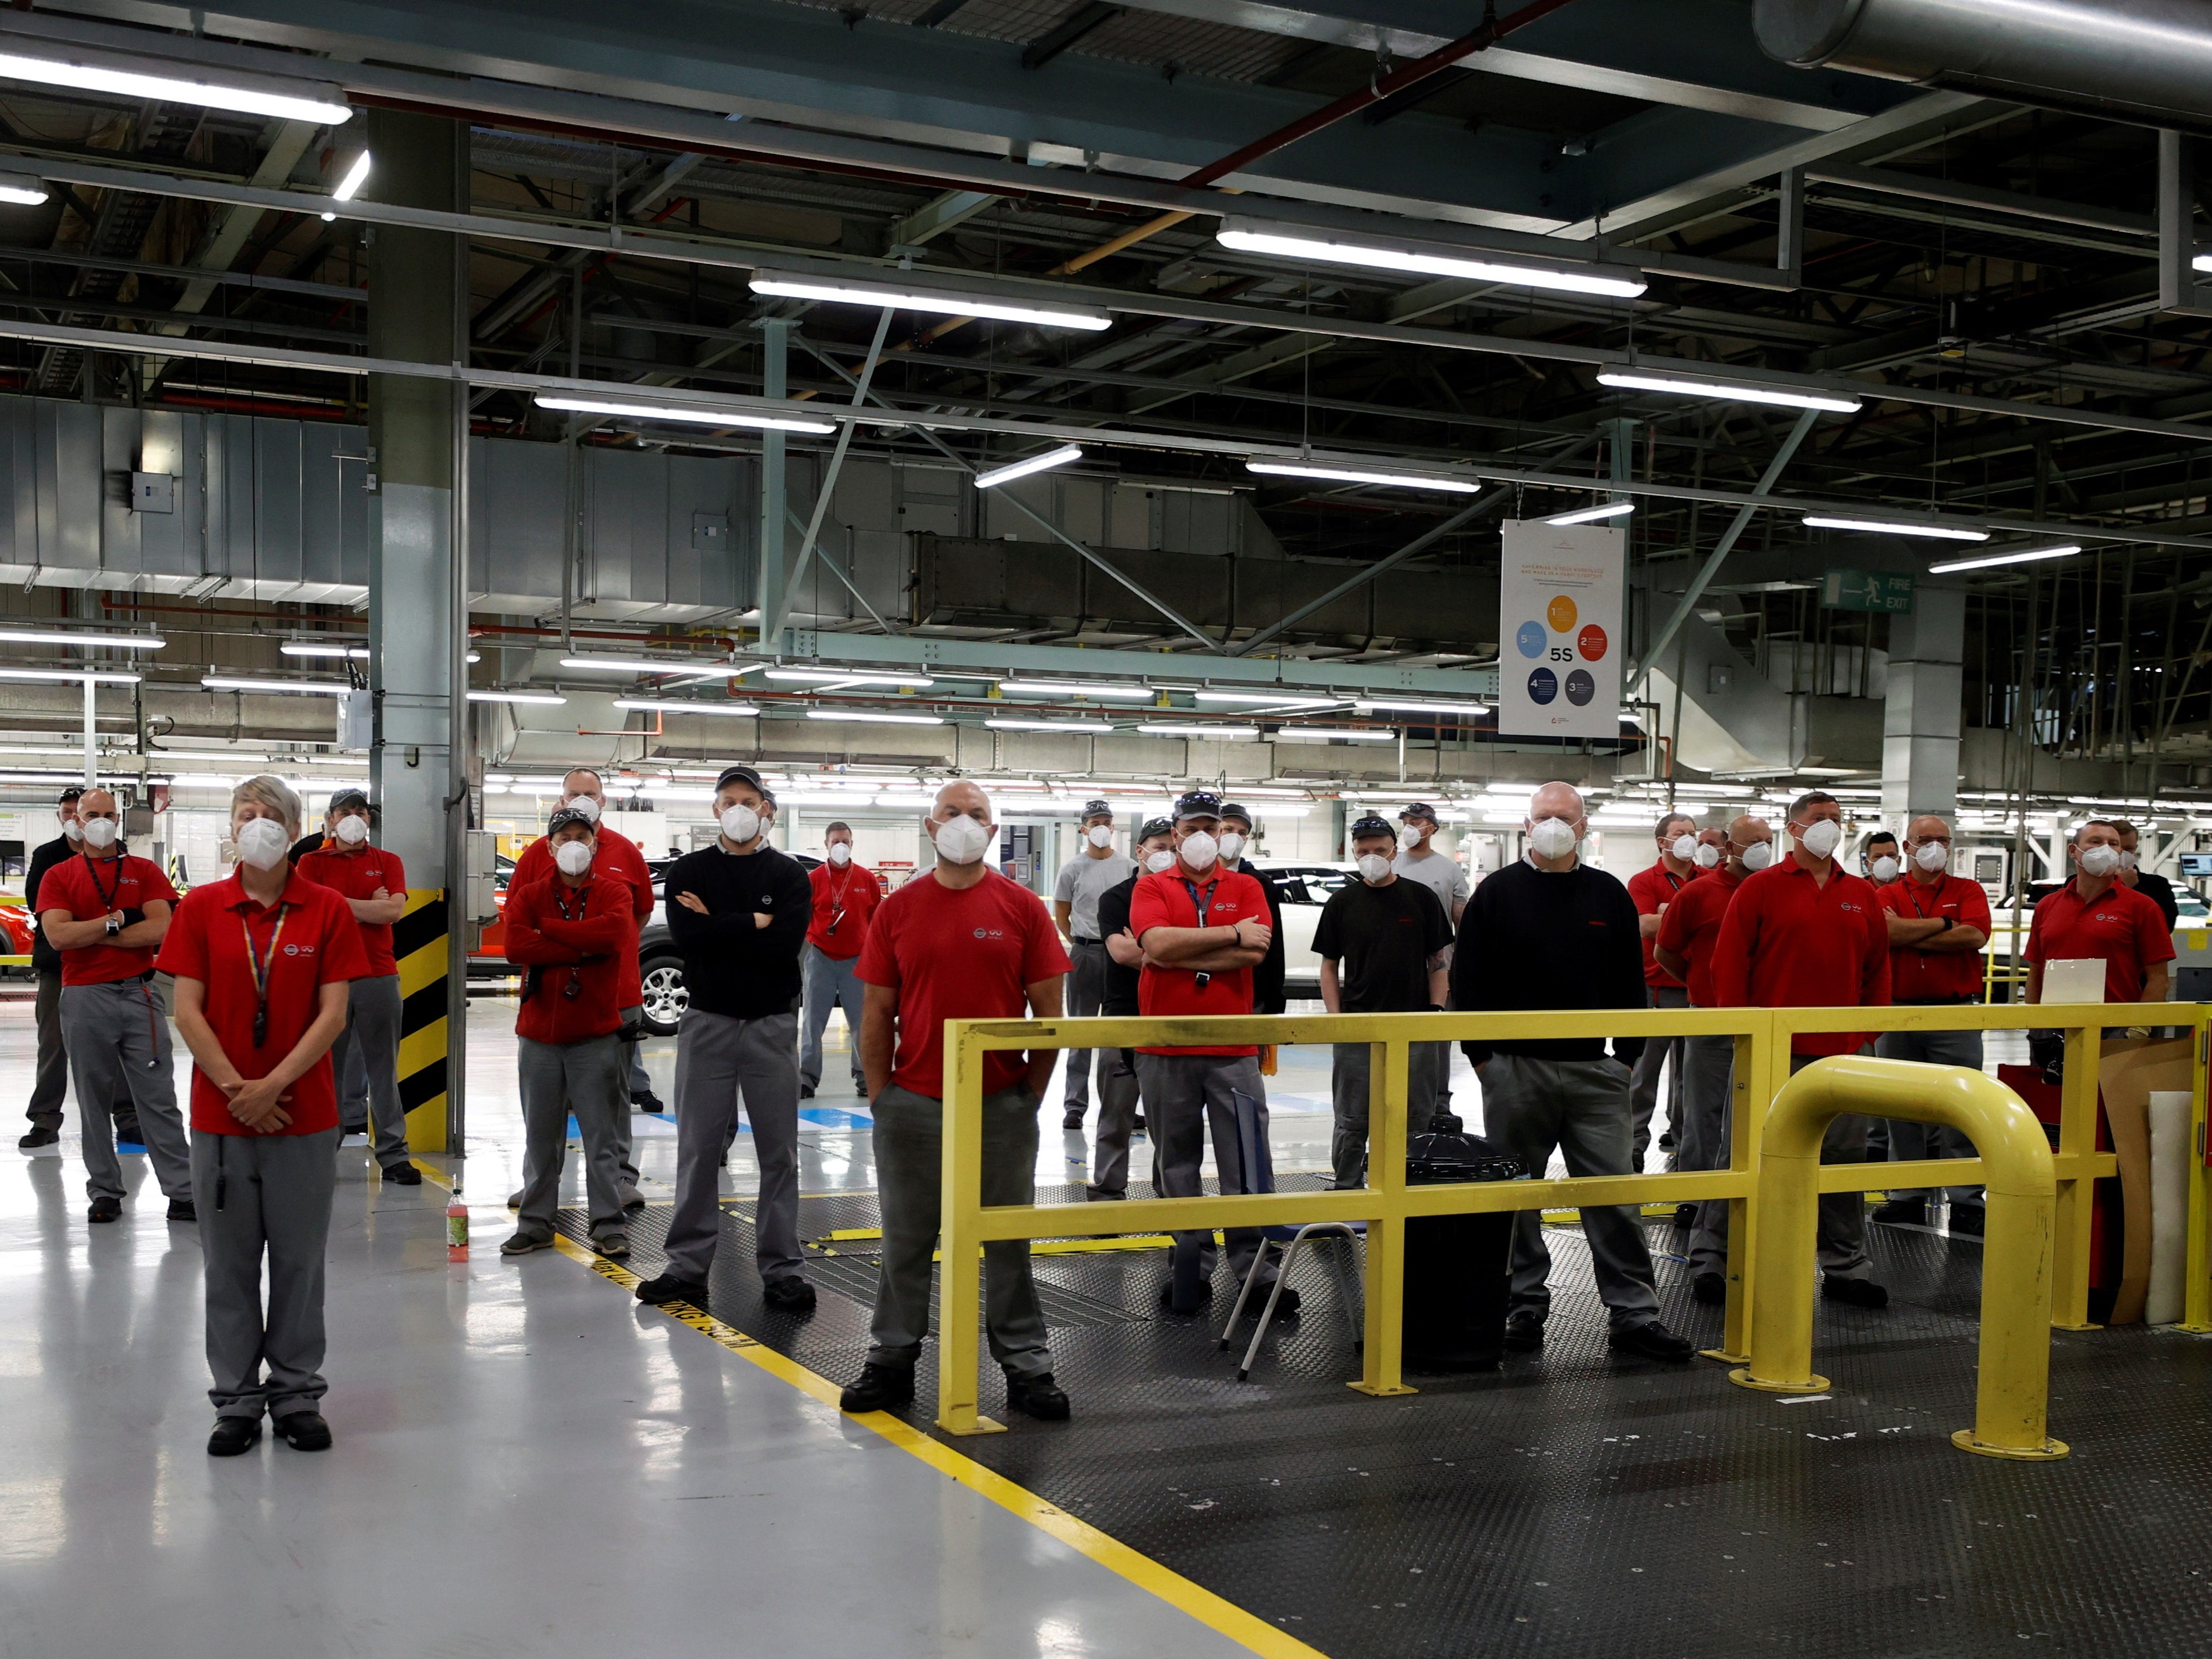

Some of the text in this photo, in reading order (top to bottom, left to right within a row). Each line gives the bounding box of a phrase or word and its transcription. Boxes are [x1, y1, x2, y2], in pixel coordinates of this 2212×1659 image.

[1889, 577, 1910, 591] FIRE
[1886, 597, 1908, 609] EXIT
[1551, 608, 1556, 616] 1
[1521, 635, 1528, 643] 5
[1580, 637, 1587, 646] 2
[1550, 648, 1573, 662] 5S
[1530, 679, 1538, 688] 4
[1569, 683, 1576, 691] 3
[657, 1300, 707, 1320] 0KG
